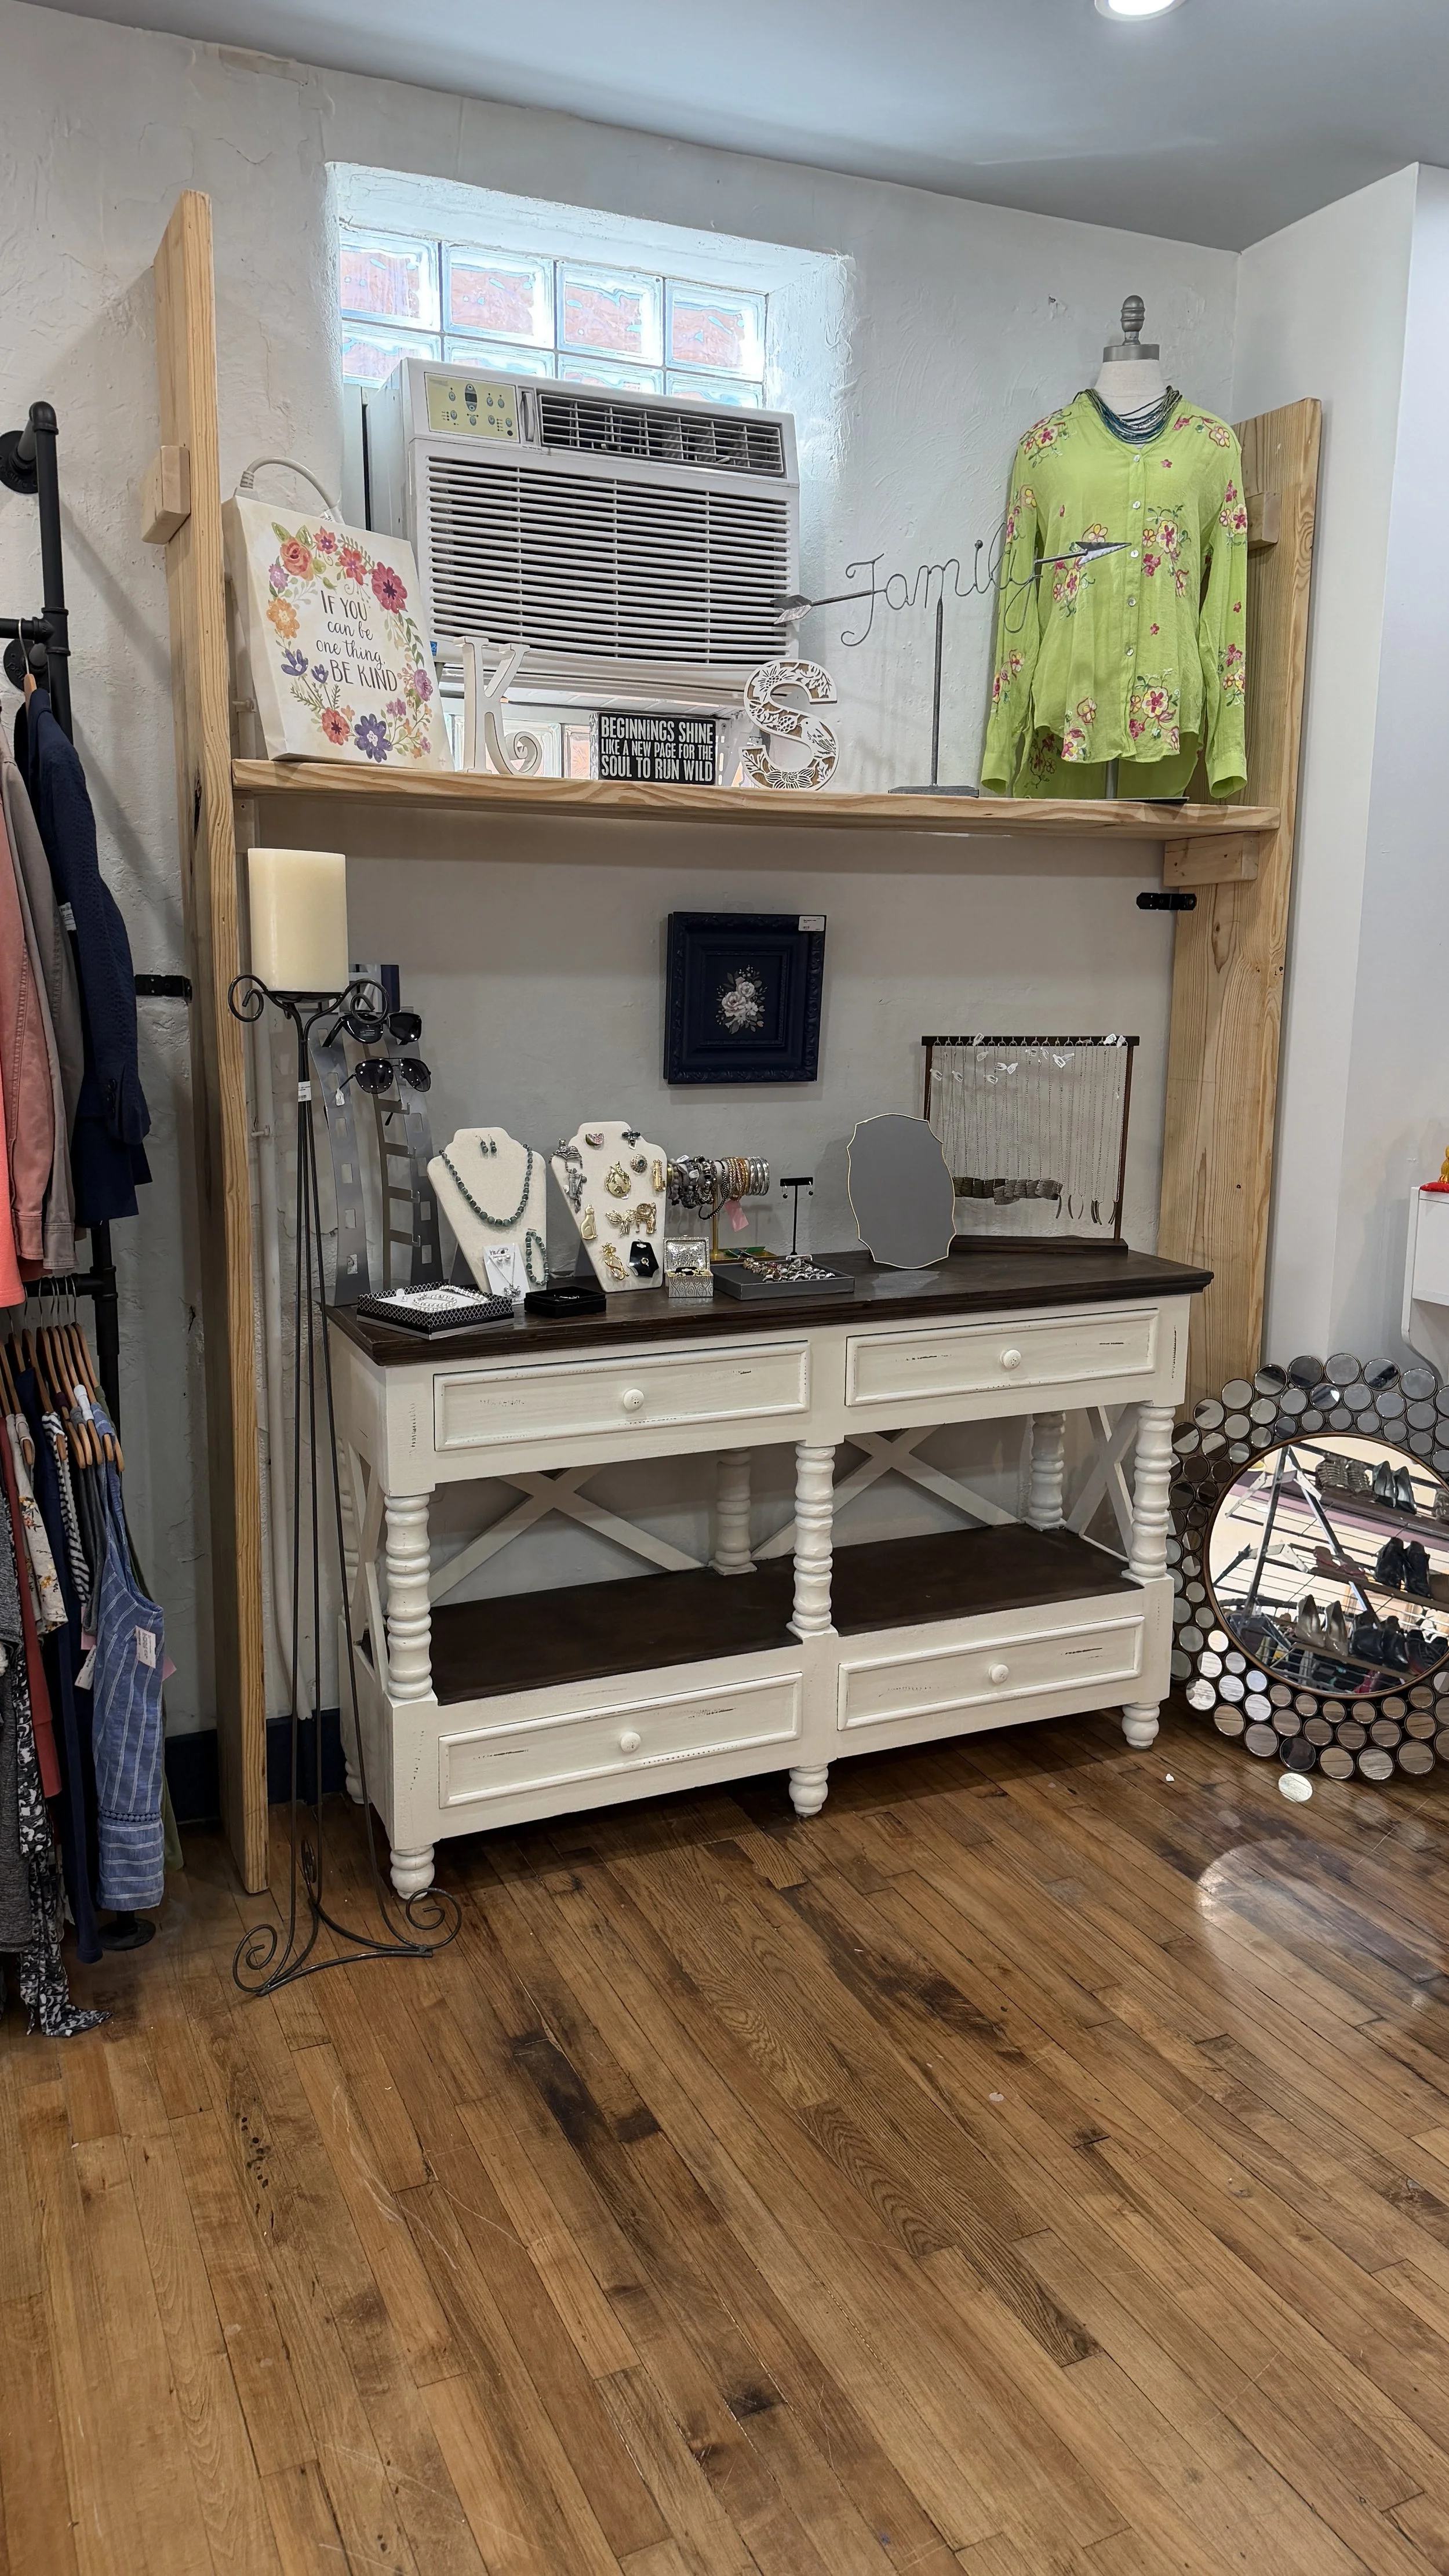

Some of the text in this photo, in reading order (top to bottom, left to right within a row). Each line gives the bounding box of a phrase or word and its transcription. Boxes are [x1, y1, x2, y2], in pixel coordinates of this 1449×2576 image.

[841, 521, 1043, 646] Family
[321, 590, 367, 621] IF YOU
[327, 621, 373, 641] can be
[316, 640, 341, 655] one
[330, 659, 398, 692] BE KIND
[454, 635, 543, 776] K
[601, 716, 713, 744] BEGINNINGS SHINE
[738, 658, 839, 791] S
[601, 738, 713, 761] LIKE A NEW PAGE FOR THE
[601, 755, 713, 782] SOUL TO RUN WILD
